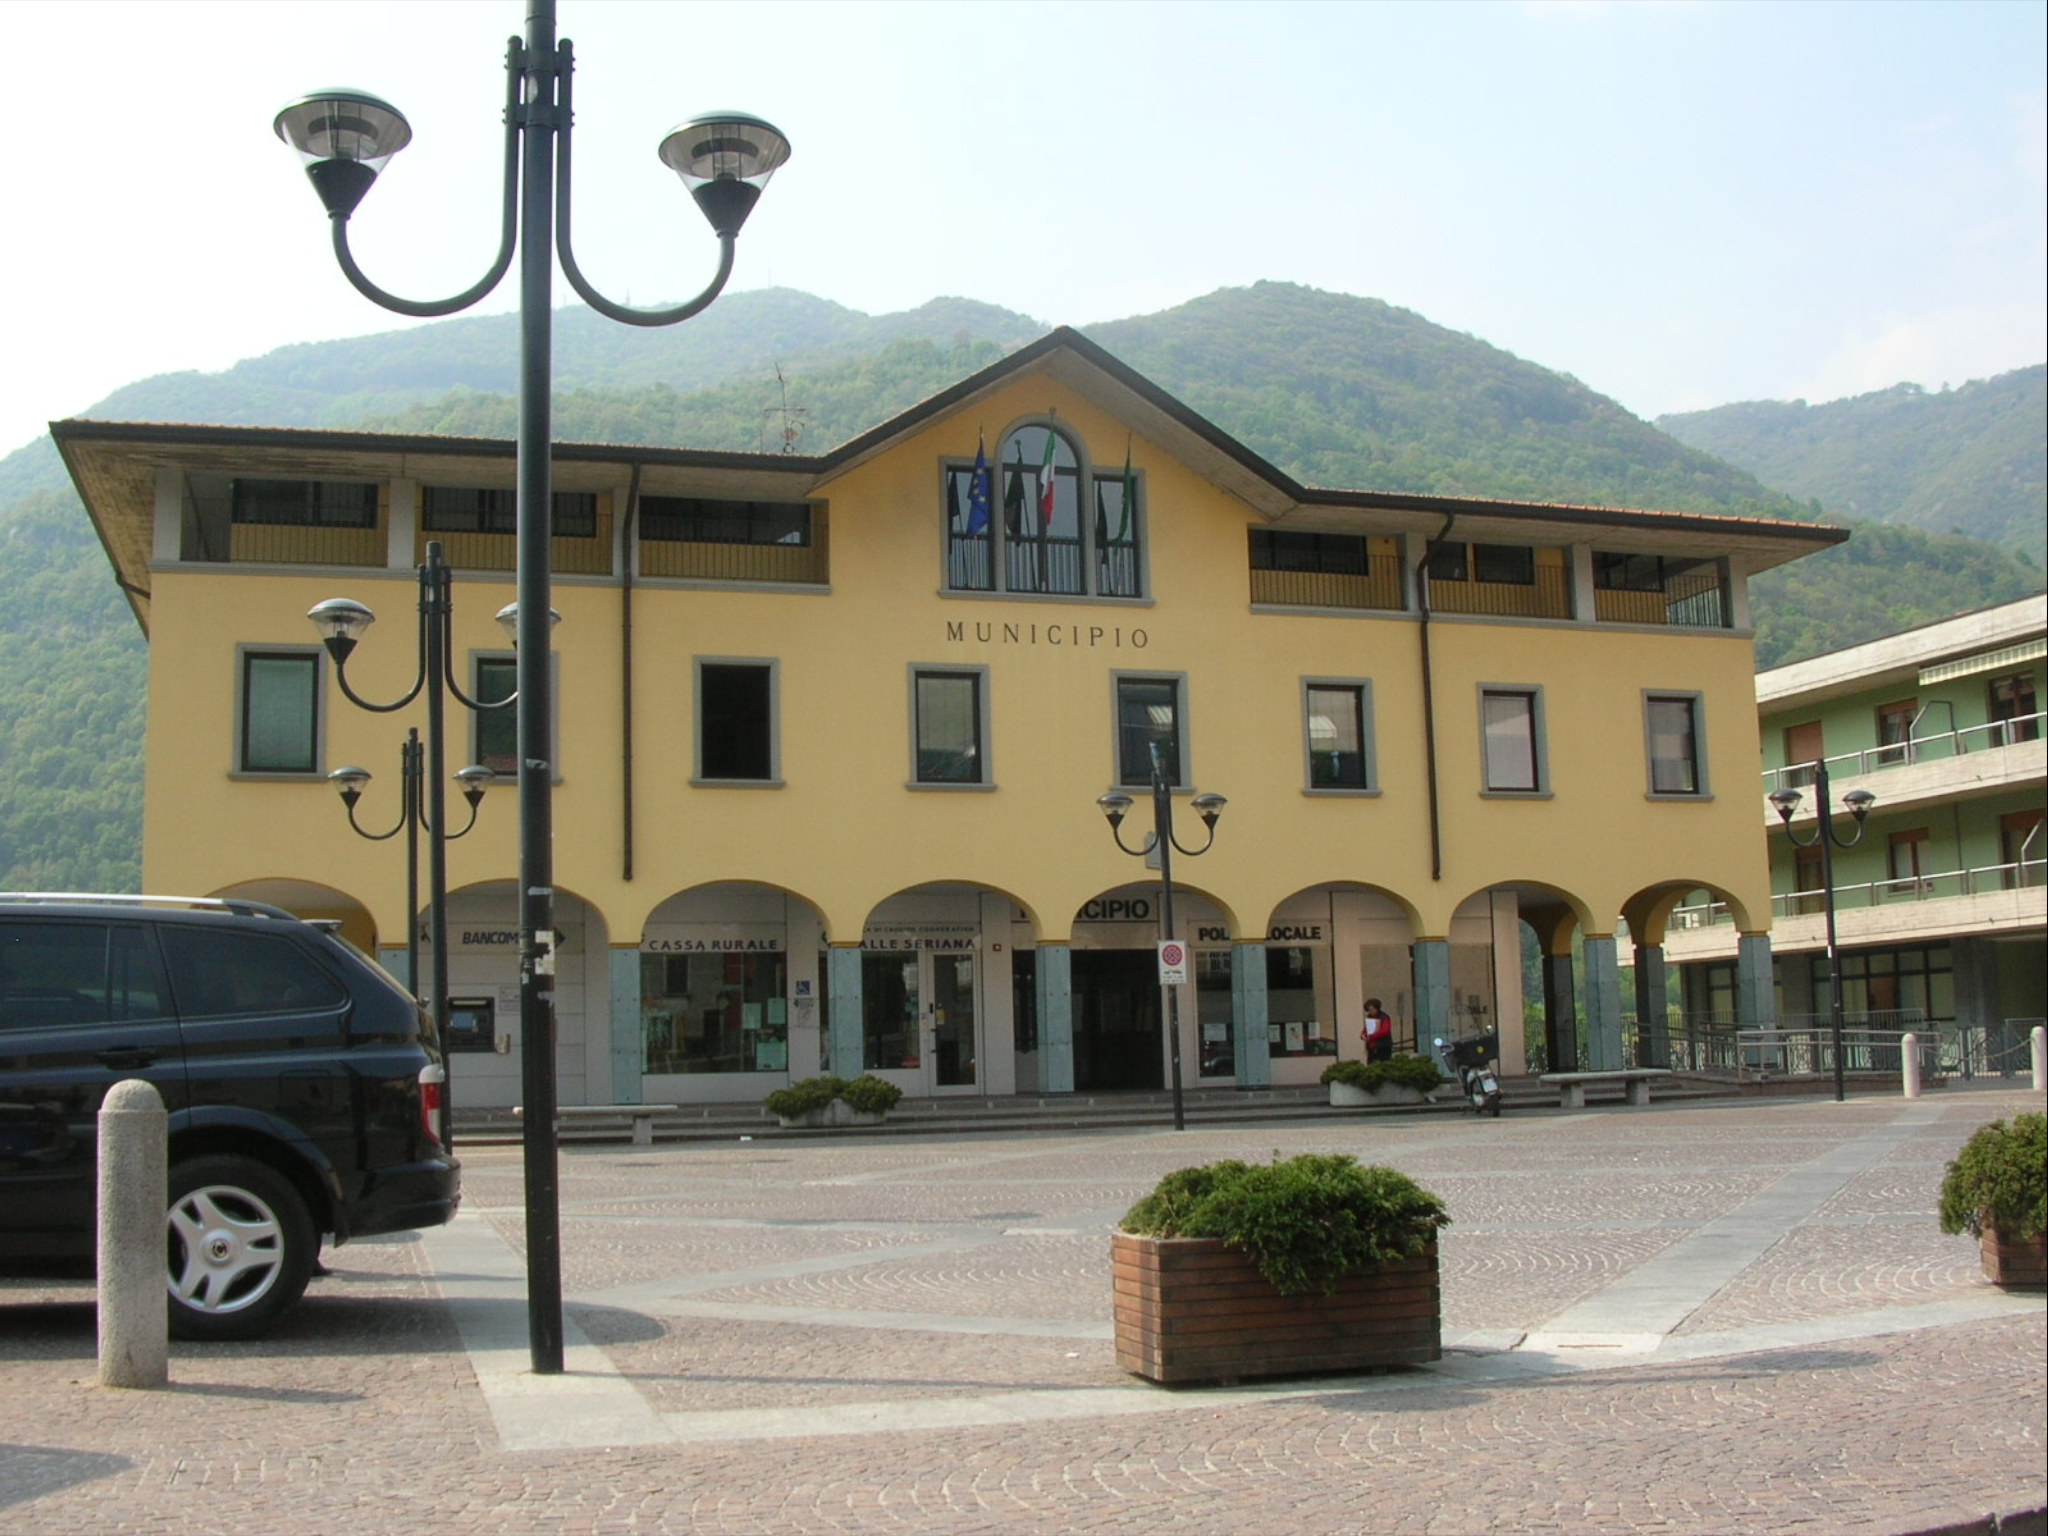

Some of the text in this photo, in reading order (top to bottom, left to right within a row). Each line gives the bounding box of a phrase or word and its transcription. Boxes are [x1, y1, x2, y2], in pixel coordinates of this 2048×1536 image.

[946, 620, 1149, 649] MUNICIPIO
[462, 931, 519, 944] BANCOM
[1198, 927, 1230, 941] POL
[649, 939, 778, 951] CASSA RURALE
[858, 938, 975, 949] ALLE SERIANA
